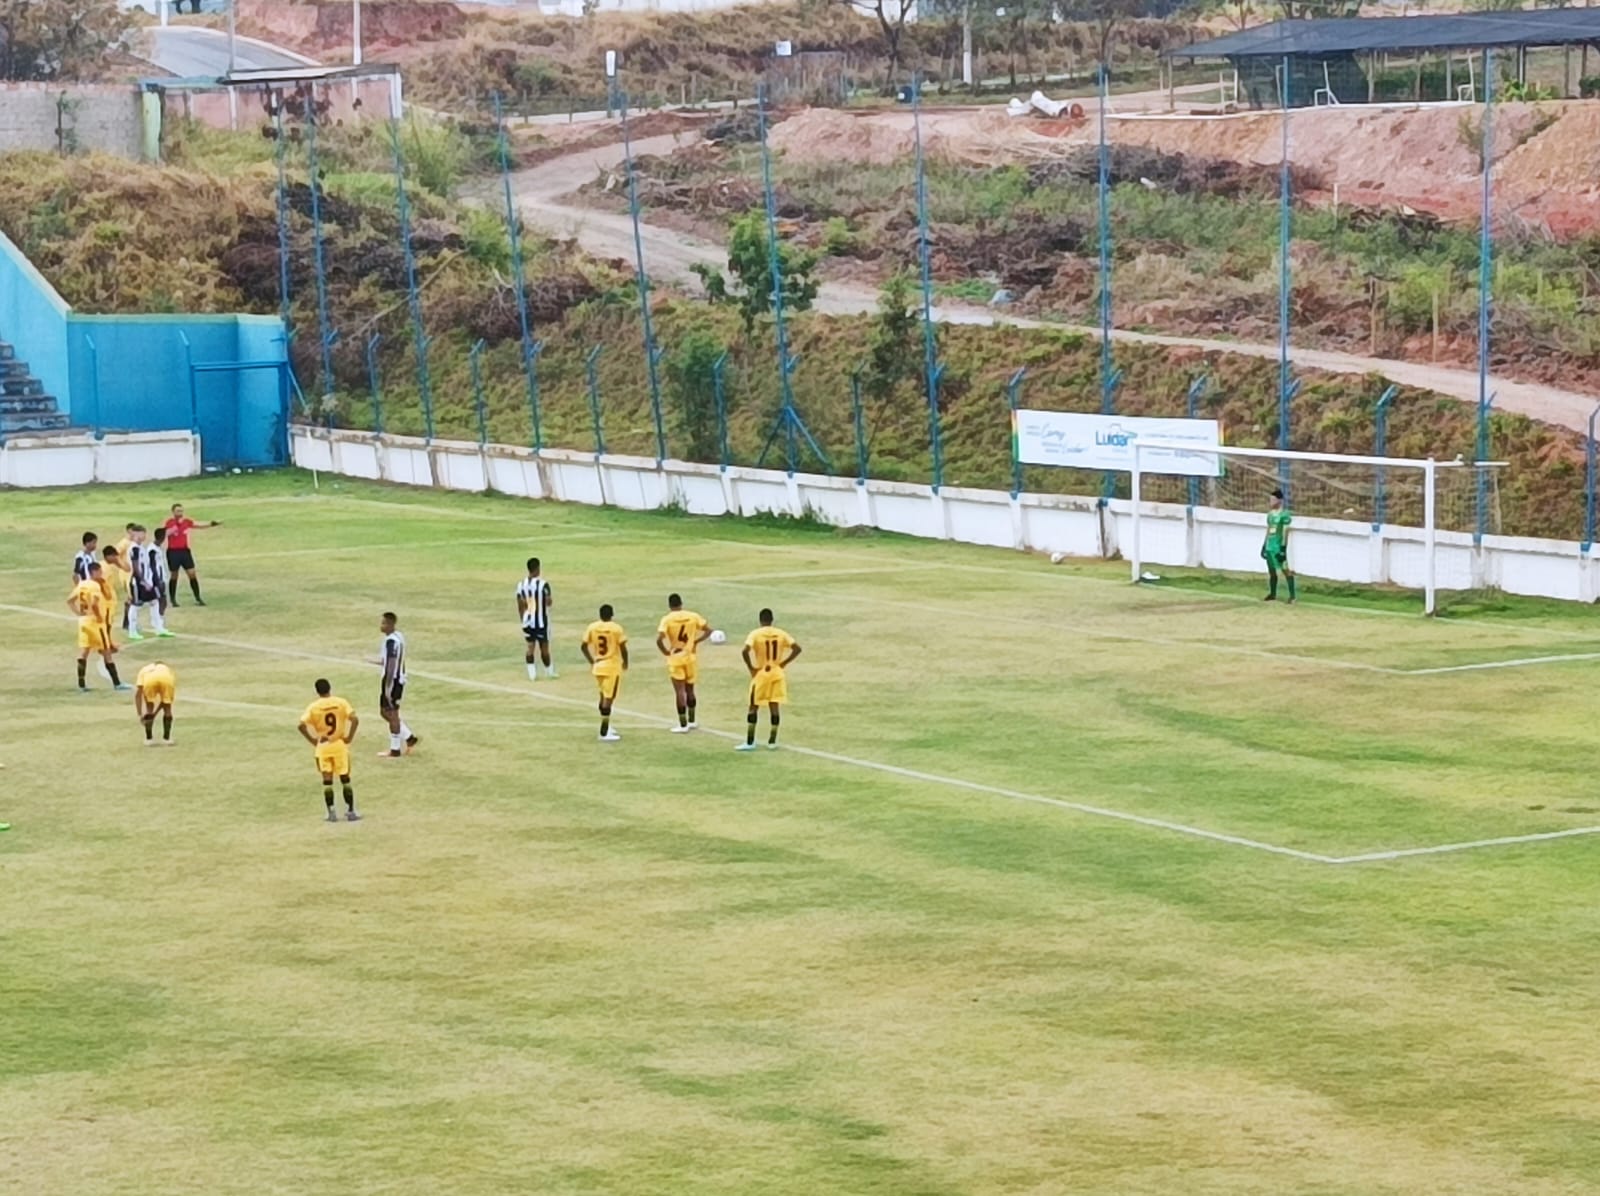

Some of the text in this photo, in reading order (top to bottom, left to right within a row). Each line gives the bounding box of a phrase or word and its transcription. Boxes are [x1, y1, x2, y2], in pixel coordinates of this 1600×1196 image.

[677, 624, 689, 643] 4
[597, 635, 609, 656] 3
[764, 639, 779, 661] 11
[324, 712, 337, 737] 9
